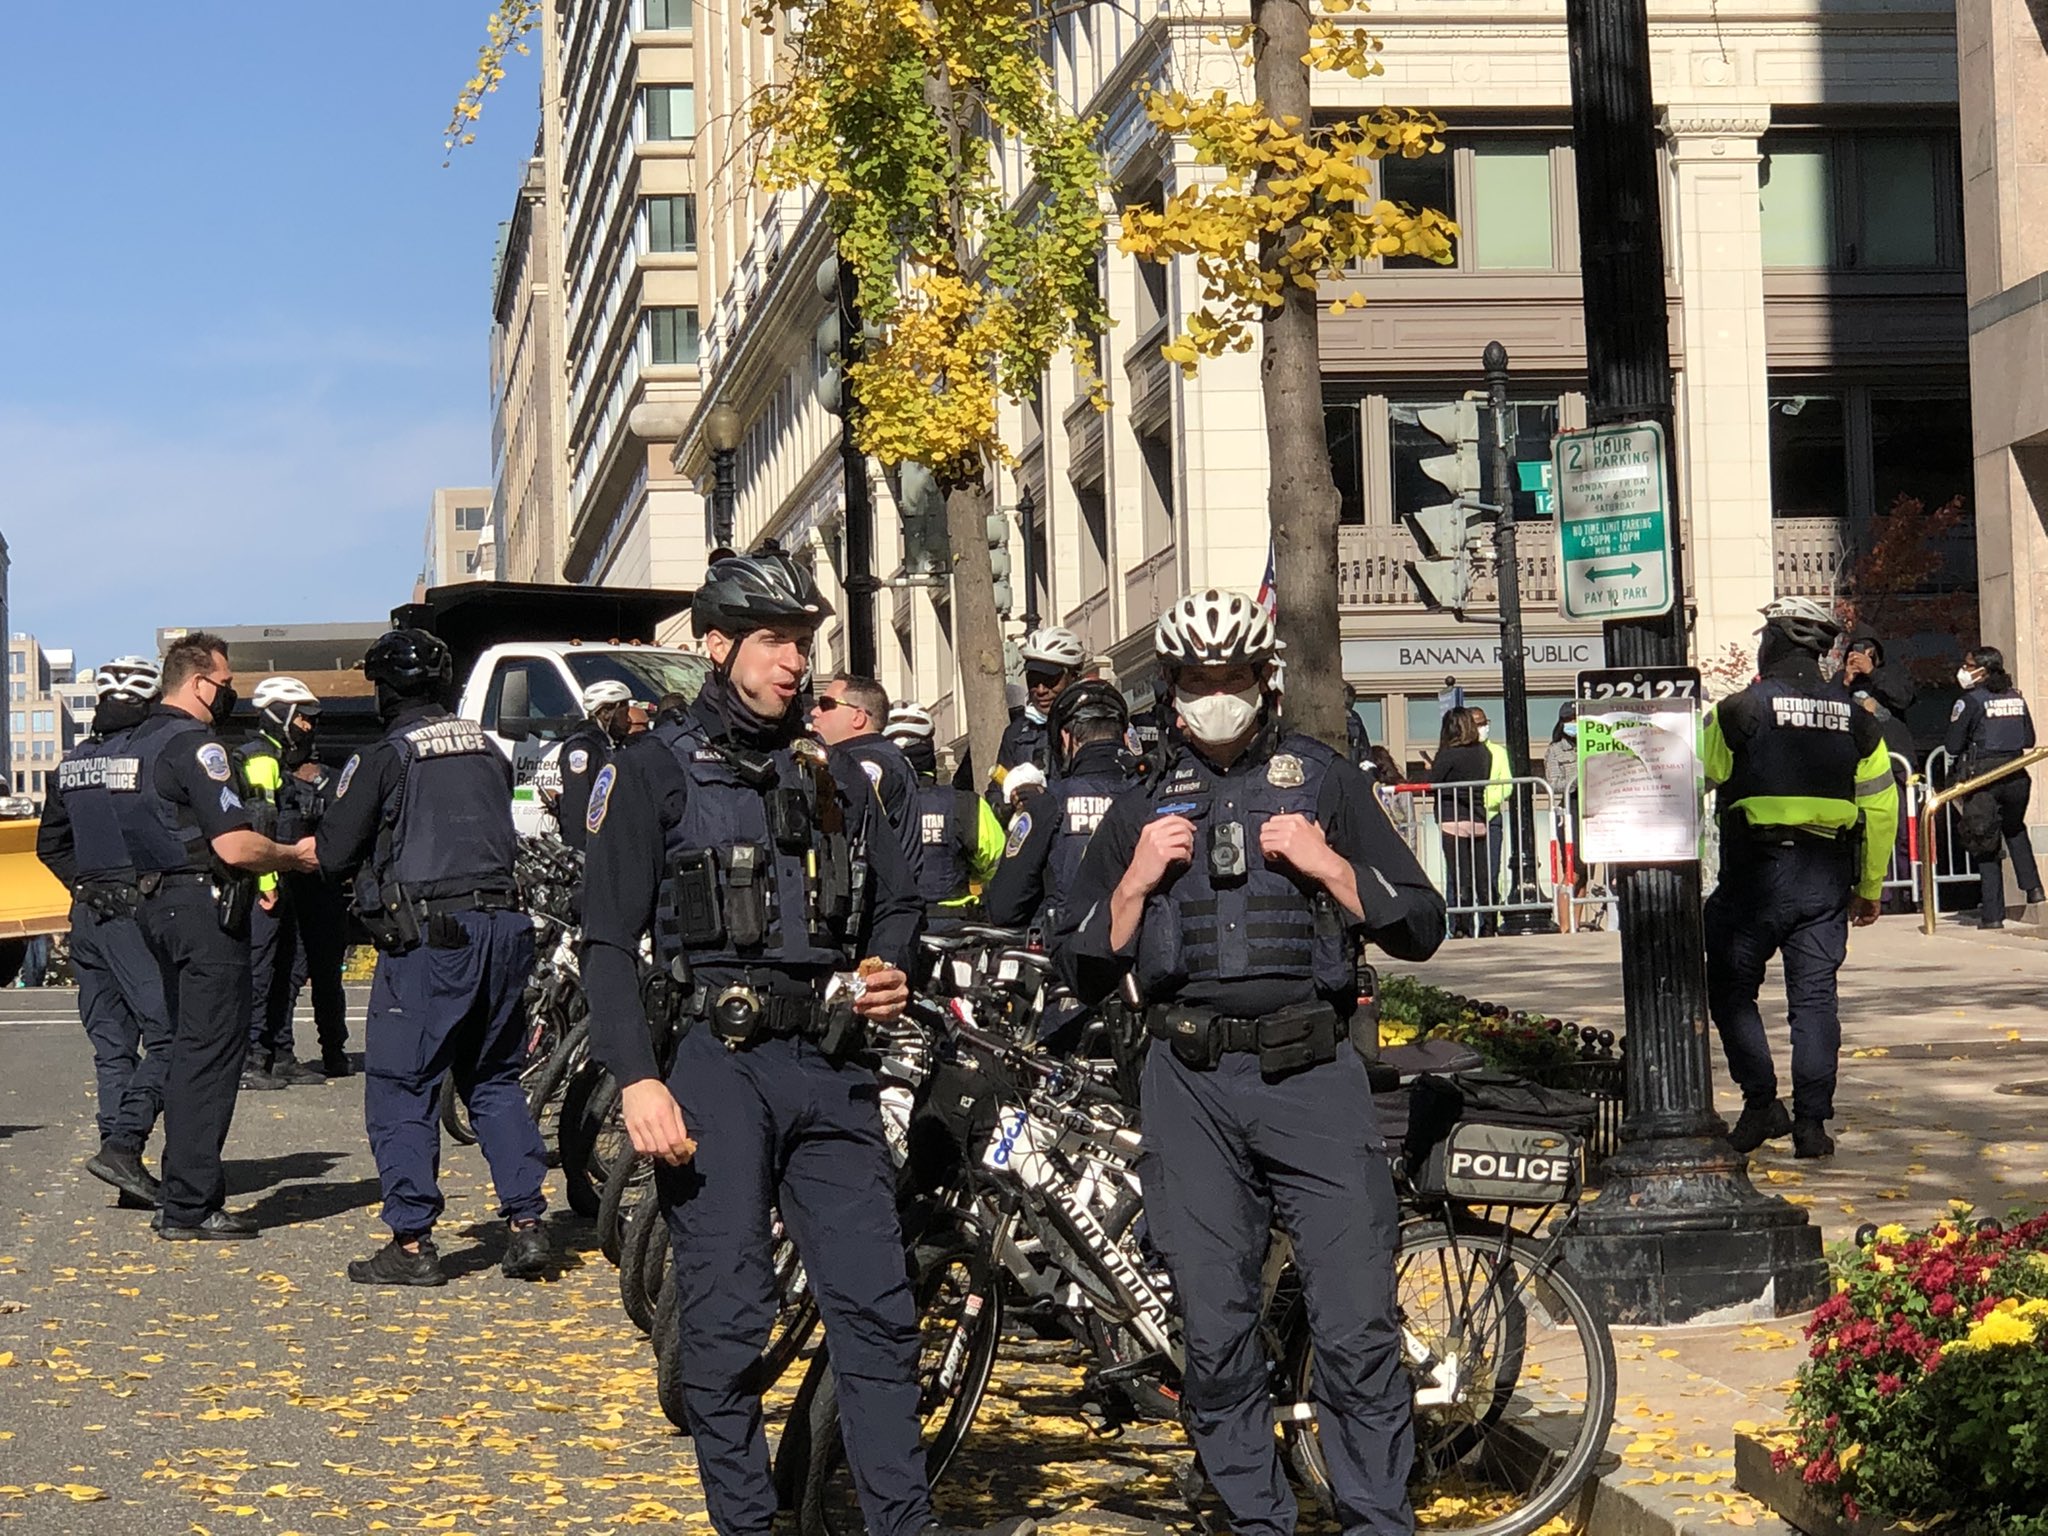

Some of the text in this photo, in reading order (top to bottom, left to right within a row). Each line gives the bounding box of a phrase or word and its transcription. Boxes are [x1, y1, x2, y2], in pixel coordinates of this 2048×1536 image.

[1593, 437, 1632, 456] HOUR
[1568, 443, 1583, 470] 2
[1593, 451, 1650, 469] PARKING
[1571, 481, 1609, 493] MONDAY
[1619, 477, 1651, 488] FRDAY
[1585, 493, 1604, 503] 7AM
[1613, 488, 1646, 500] 630PM
[1594, 500, 1636, 513] SATURDAY
[1572, 516, 1652, 537] NO TIME LIMIT PARKING
[1580, 534, 1611, 547] 6:30PM
[1619, 531, 1641, 543] 10PM
[1584, 590, 1604, 604] PAY
[1622, 586, 1648, 600] PARK
[1771, 608, 1797, 616] POLICE
[1400, 645, 1589, 665] BANANA RPUBLIC
[1596, 680, 1695, 700] 22127
[1772, 697, 1851, 717] METROPOLITAN
[1585, 721, 1612, 735] Pay
[1776, 711, 1850, 731] POLICE
[403, 720, 482, 742] METROPOLITAN
[416, 734, 486, 757] POLICE
[60, 757, 109, 774] METROPOLITA
[517, 756, 560, 771] United
[516, 772, 563, 786] Rentals
[1034, 1105, 1092, 1134] OLICE
[1451, 1152, 1570, 1182] POLICE
